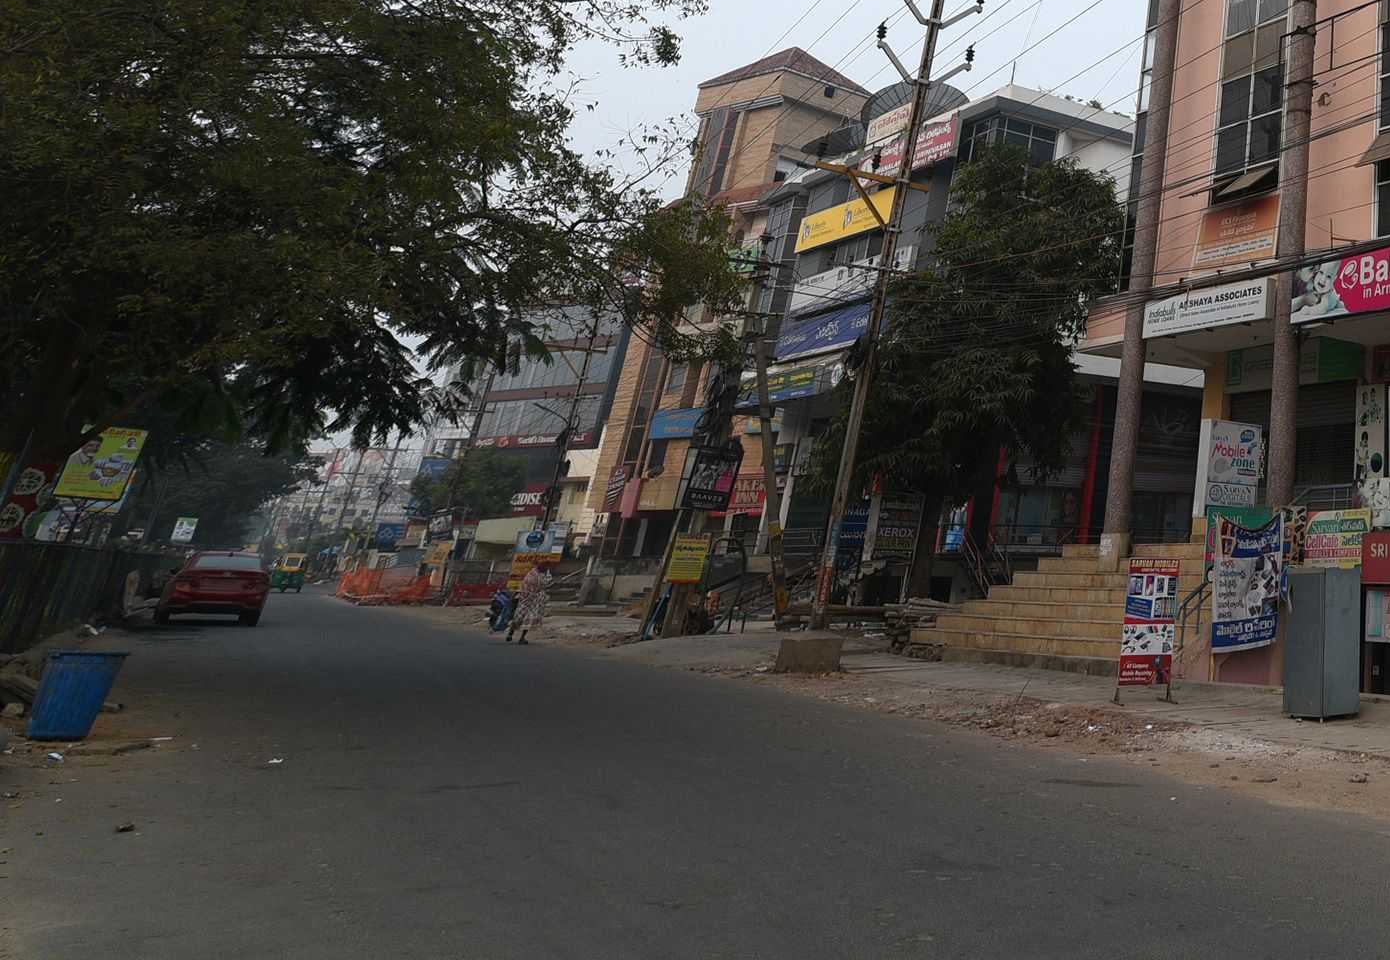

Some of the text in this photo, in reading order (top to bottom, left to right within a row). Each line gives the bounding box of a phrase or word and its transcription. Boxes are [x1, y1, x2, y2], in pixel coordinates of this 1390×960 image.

[1214, 286, 1262, 303] ASSOCIATES
[1363, 285, 1373, 299] in
[1212, 442, 1246, 458] Mobile
[1230, 458, 1255, 469] zone
[877, 527, 915, 538] XEROX
[1370, 543, 1388, 558] SRI
